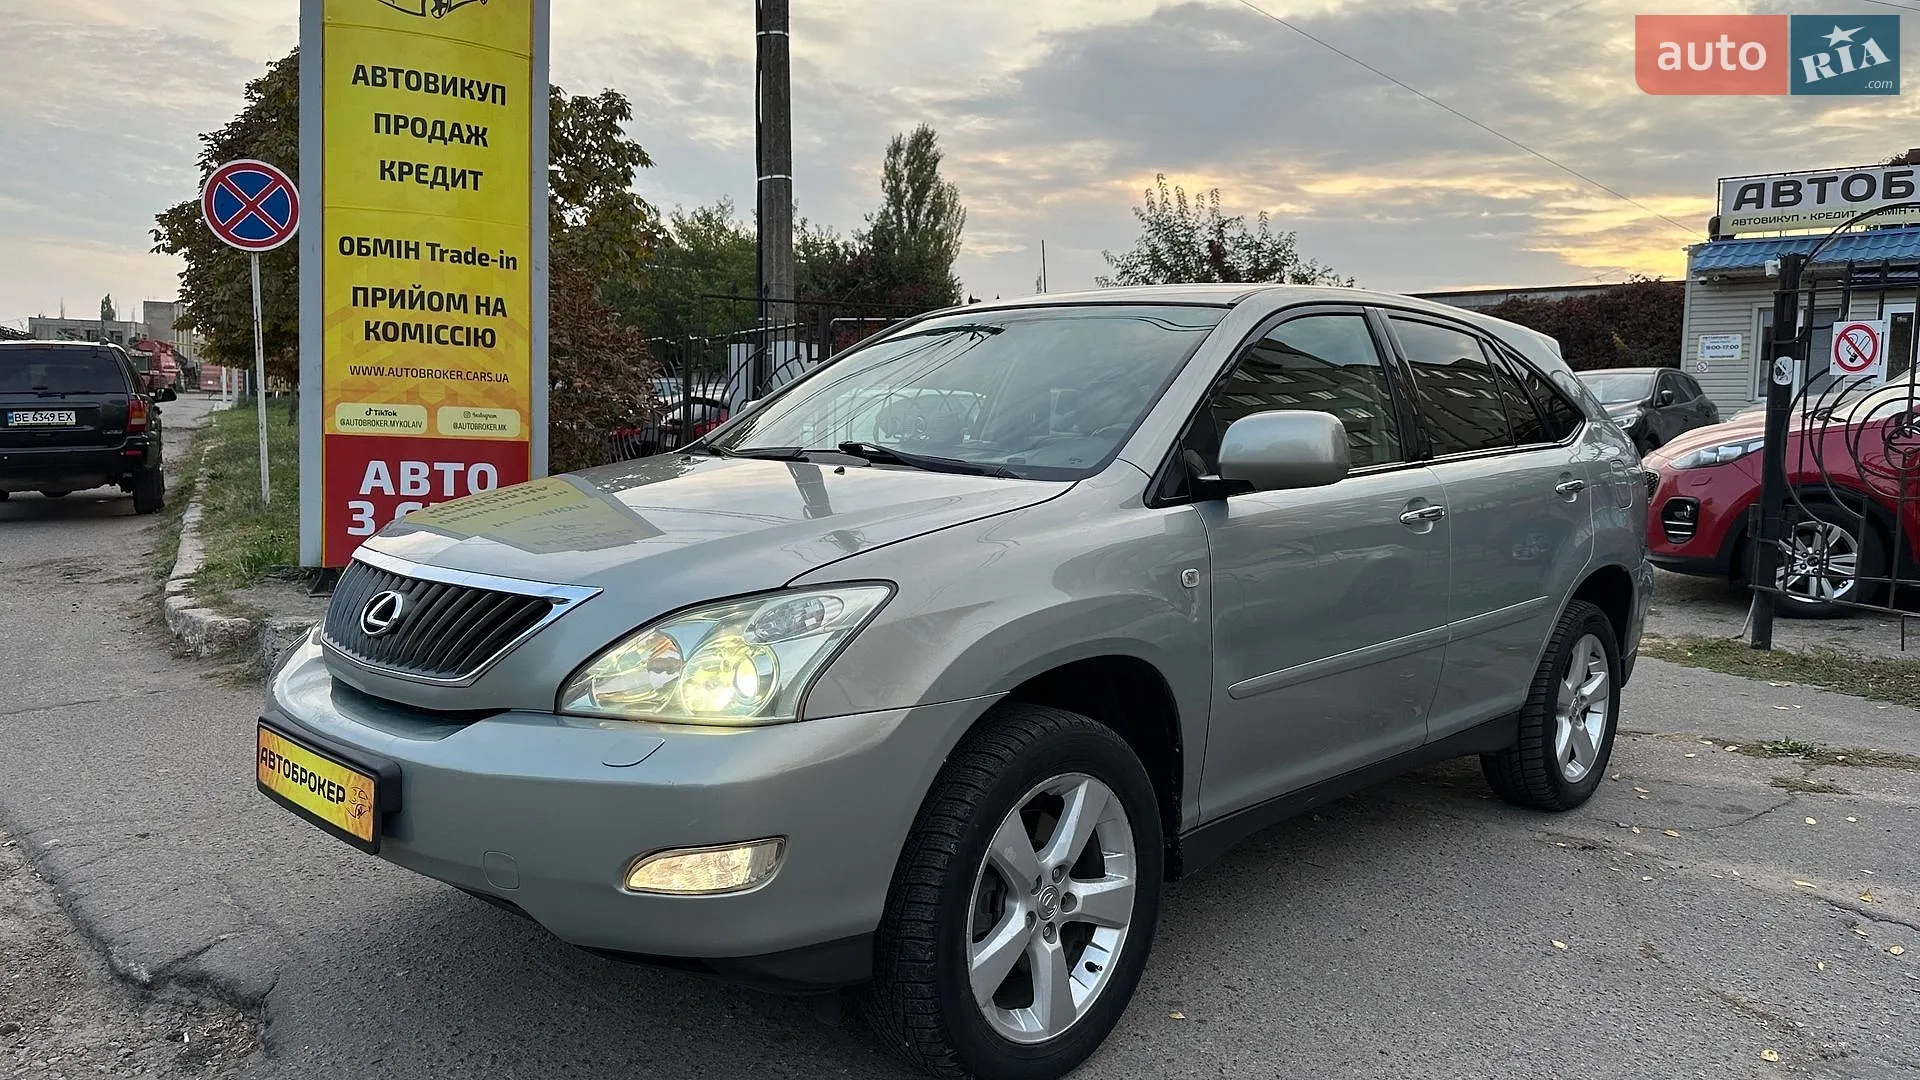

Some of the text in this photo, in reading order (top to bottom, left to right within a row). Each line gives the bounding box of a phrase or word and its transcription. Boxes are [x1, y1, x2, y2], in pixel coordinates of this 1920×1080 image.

[351, 64, 506, 106] АВТОВИКУП
[374, 112, 489, 147] ПРОДАЖ
[379, 159, 484, 191] КРЕДИТ
[1732, 170, 1915, 211] АВТОБ
[1731, 214, 1799, 226] АВТОВИКУП
[1810, 210, 1857, 221] КРЕДИТ
[338, 236, 518, 270] ОБМІН Trade-in
[352, 284, 508, 318] ПРИЙОМ НА
[364, 320, 497, 348] КОМІССІЮ
[349, 365, 510, 383] WWW.AUTOBROKER.CARS.UA
[14, 413, 30, 422] BE
[32, 412, 55, 422] 6349
[339, 418, 423, 429] @AUTOBROKER.MYKOLAIV
[374, 409, 398, 417] TikTok
[358, 460, 498, 497] АВТО
[260, 747, 346, 805] АВТОБРОКЕР
